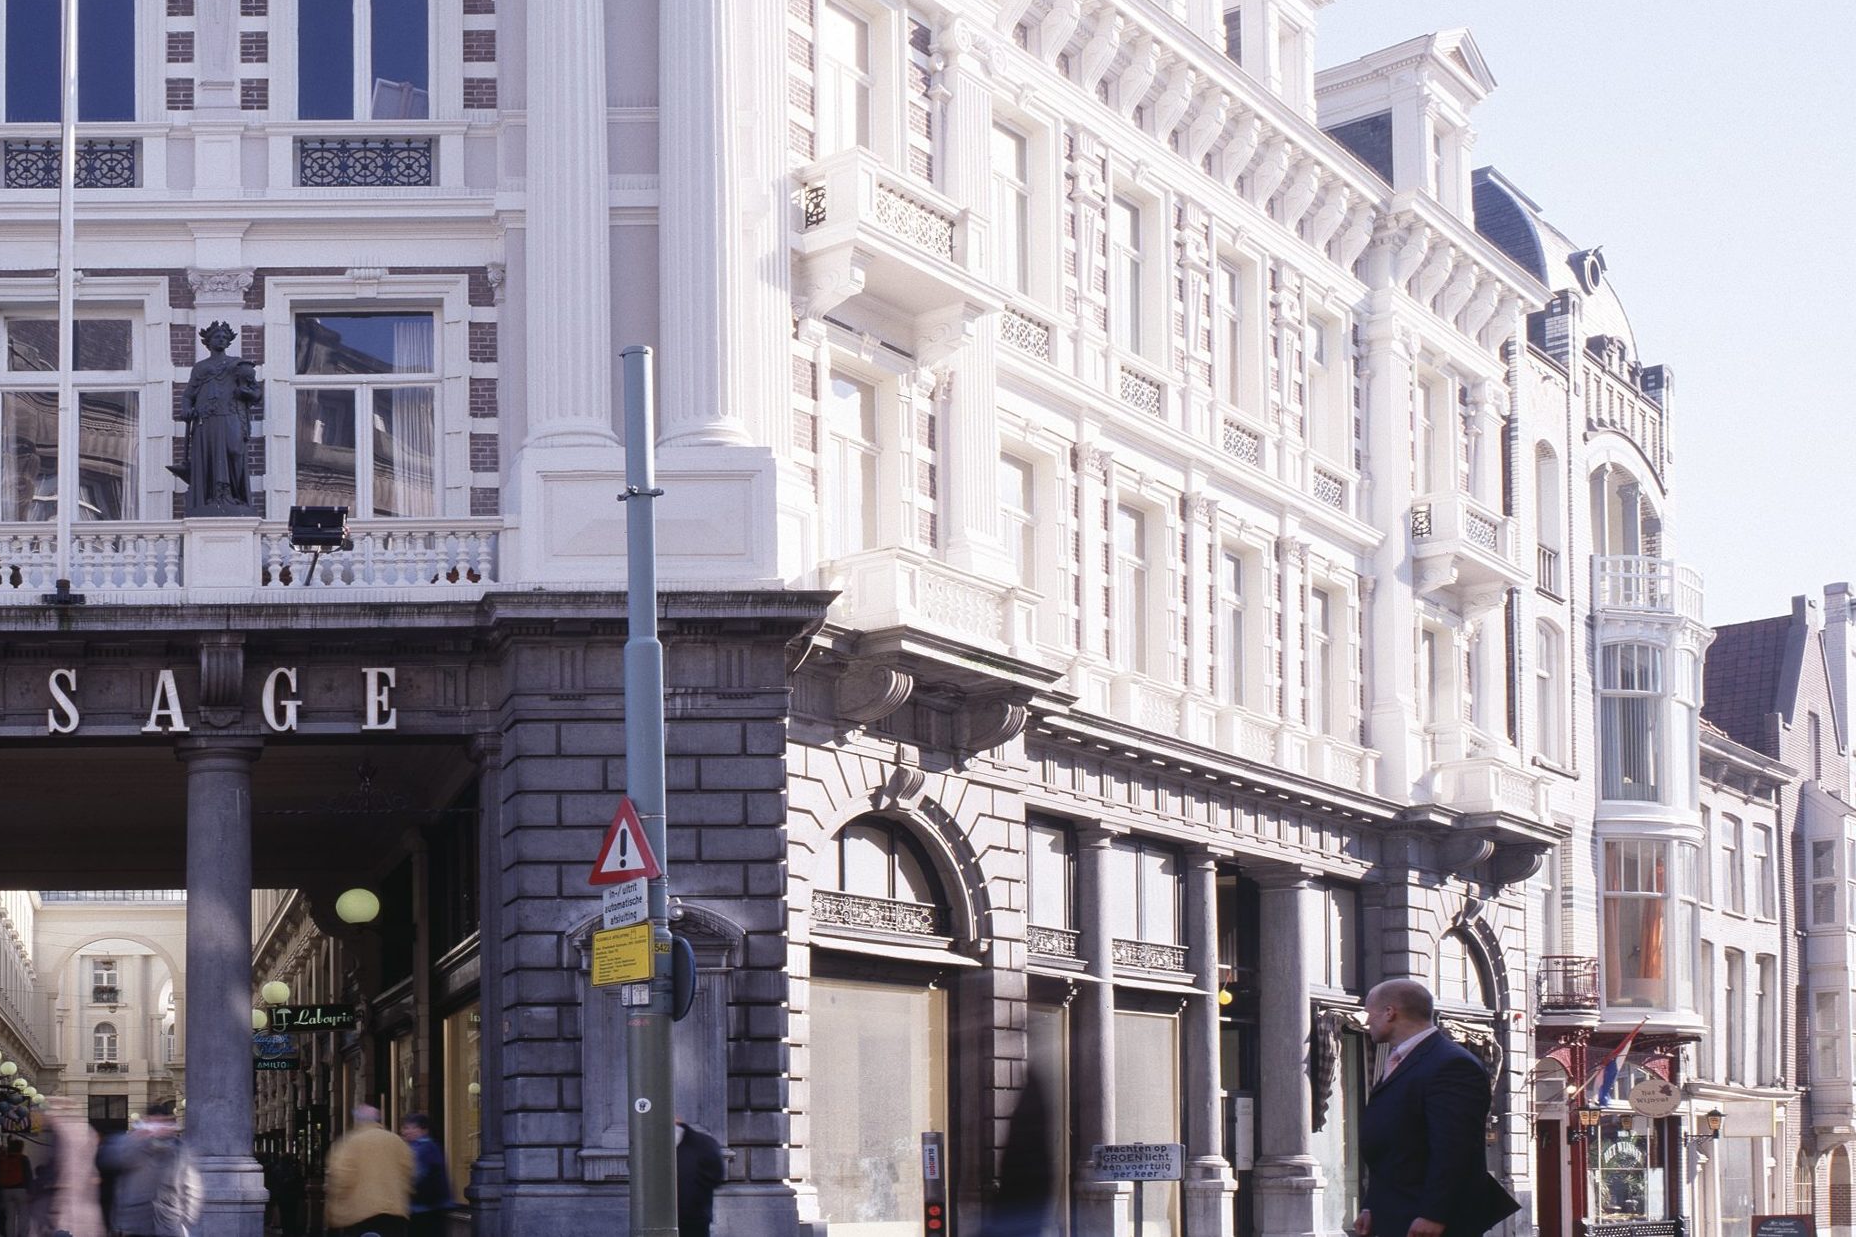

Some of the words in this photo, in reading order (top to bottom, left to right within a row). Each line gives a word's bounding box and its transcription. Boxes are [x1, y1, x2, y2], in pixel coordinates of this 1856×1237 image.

[604, 895, 642, 914] automatische
[610, 911, 637, 925] afsluiting
[1104, 1145, 1151, 1153] Wachten
[1154, 1145, 1167, 1153] op
[1103, 1154, 1143, 1163] GROEN
[1124, 1162, 1171, 1172] voertuig
[1113, 1171, 1132, 1179] per
[1134, 1170, 1159, 1178] keer
